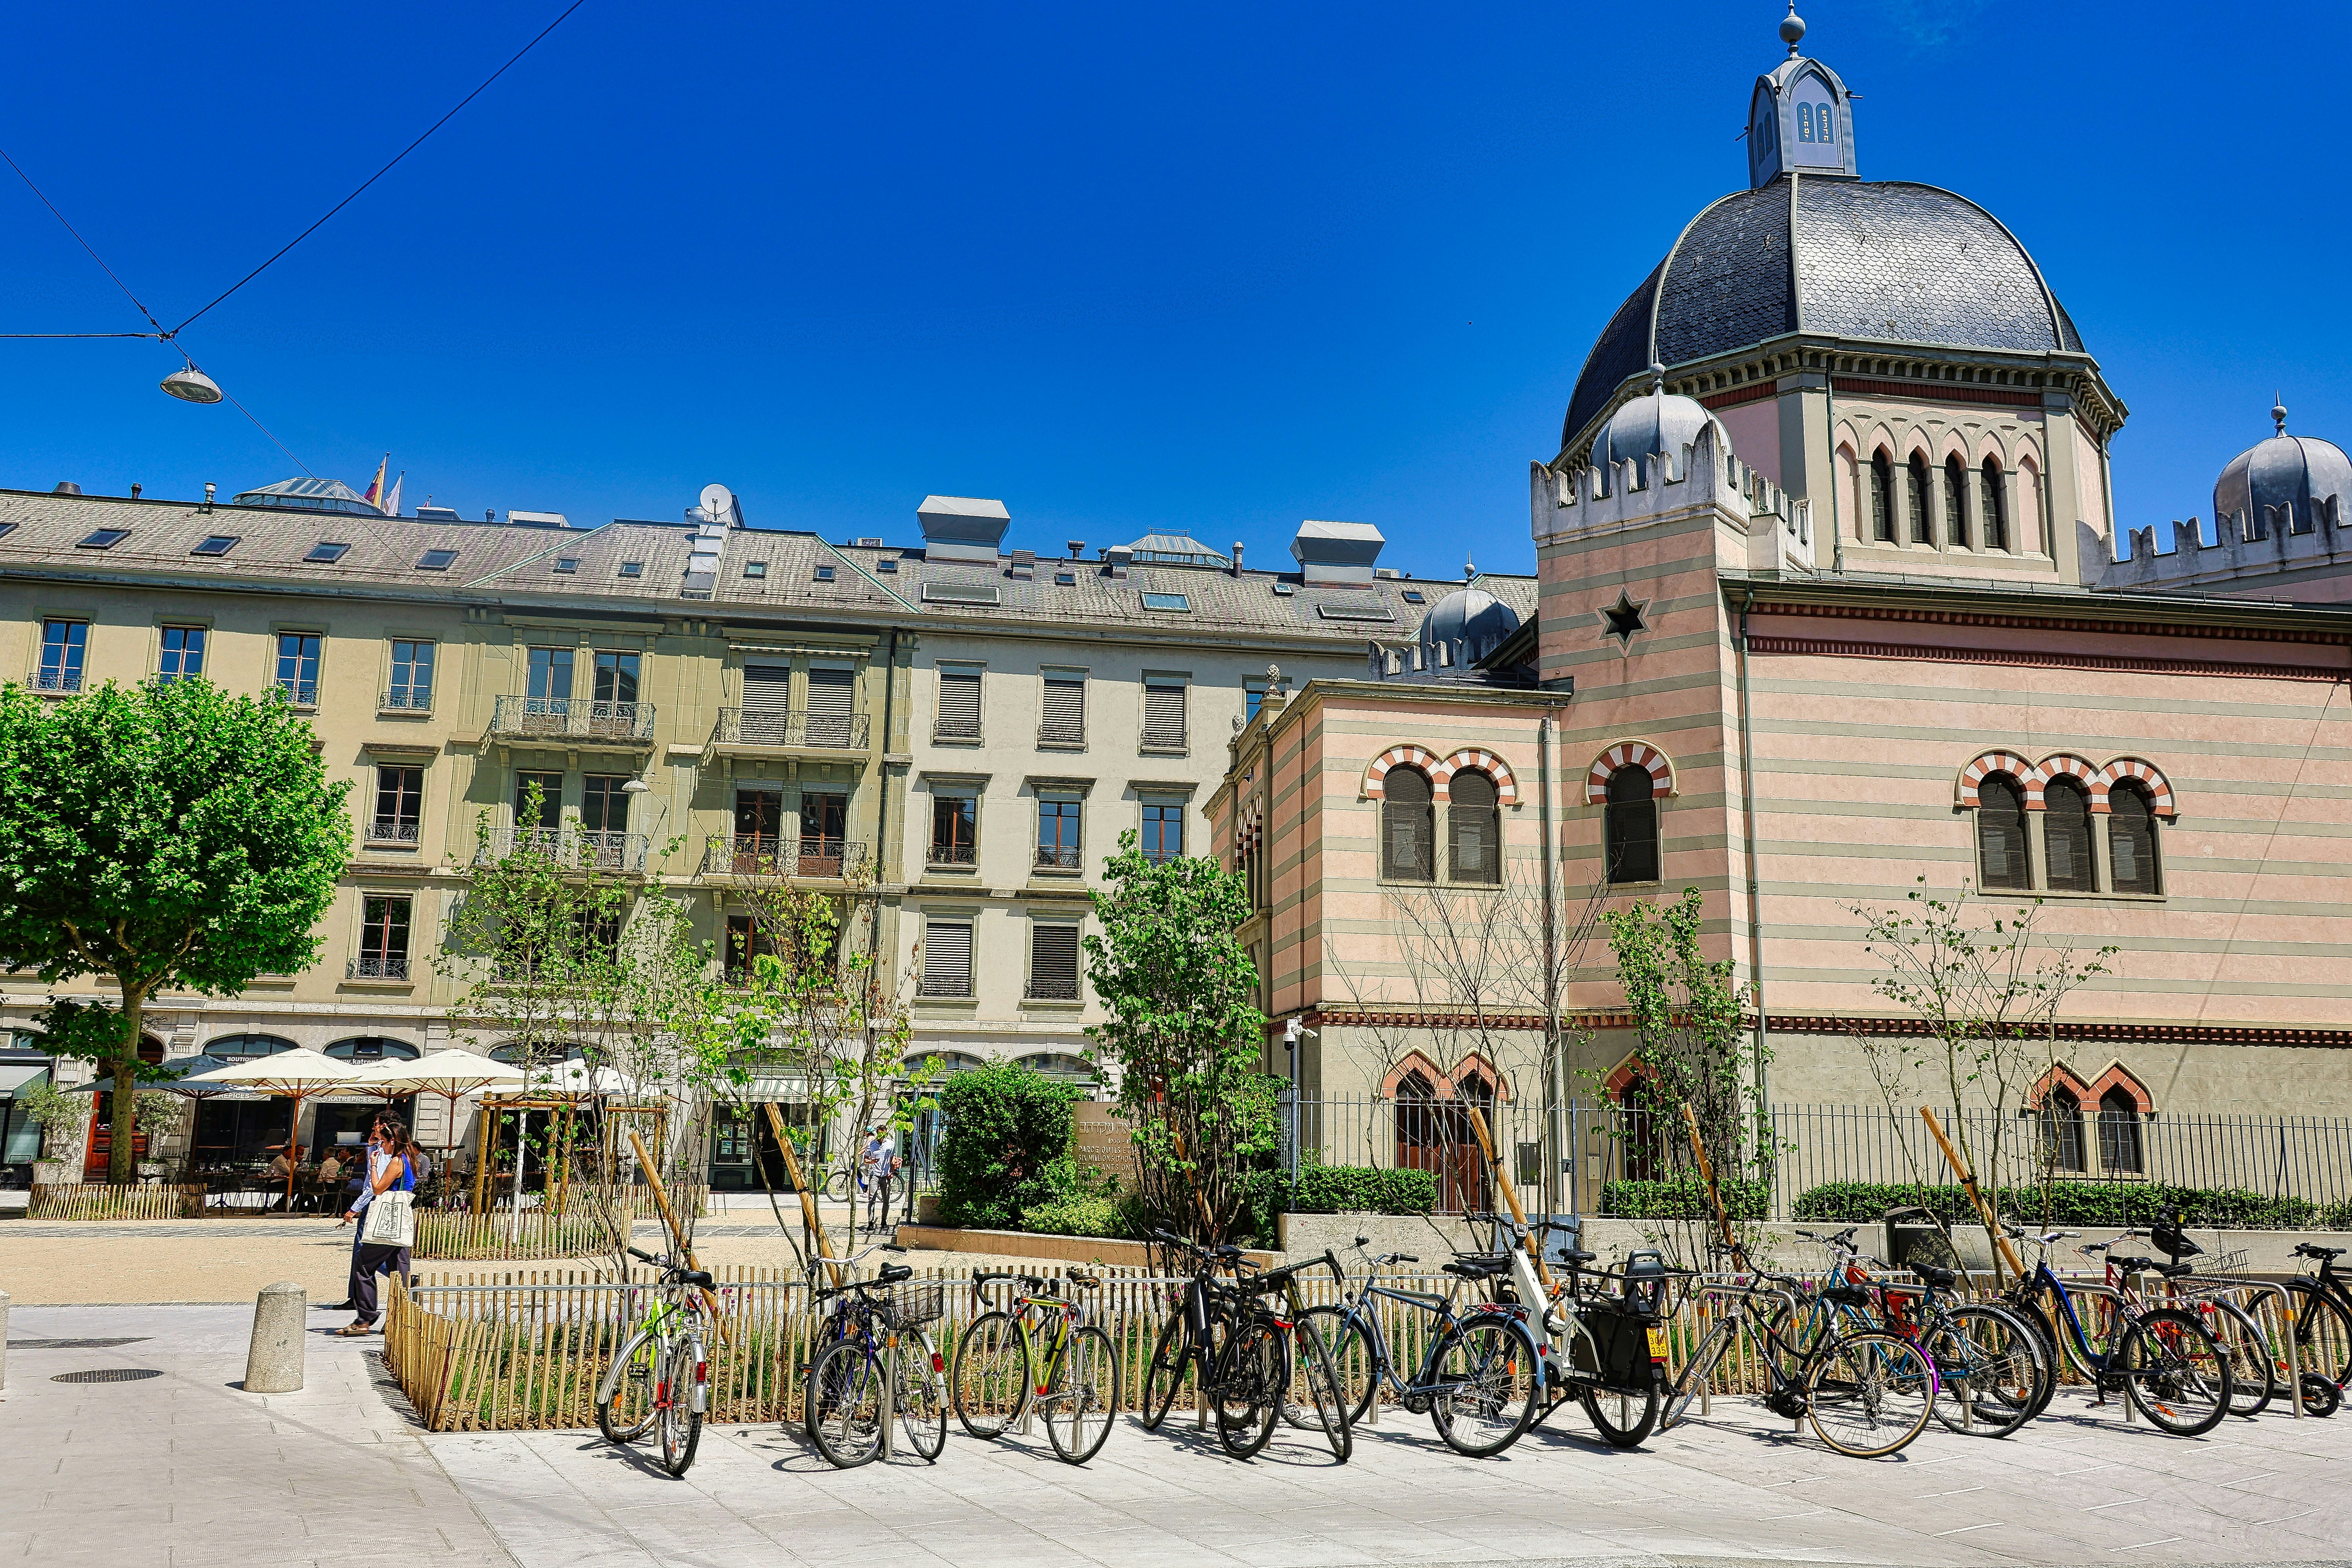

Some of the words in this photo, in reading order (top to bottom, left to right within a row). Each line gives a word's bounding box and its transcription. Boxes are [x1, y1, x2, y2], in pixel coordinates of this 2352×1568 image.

[2059, 1300, 2073, 1324] VILLIGER
[1651, 1346, 1666, 1355] 335
[1747, 1323, 1757, 1338] BIKE
[1756, 1338, 1775, 1368] PROJECT
